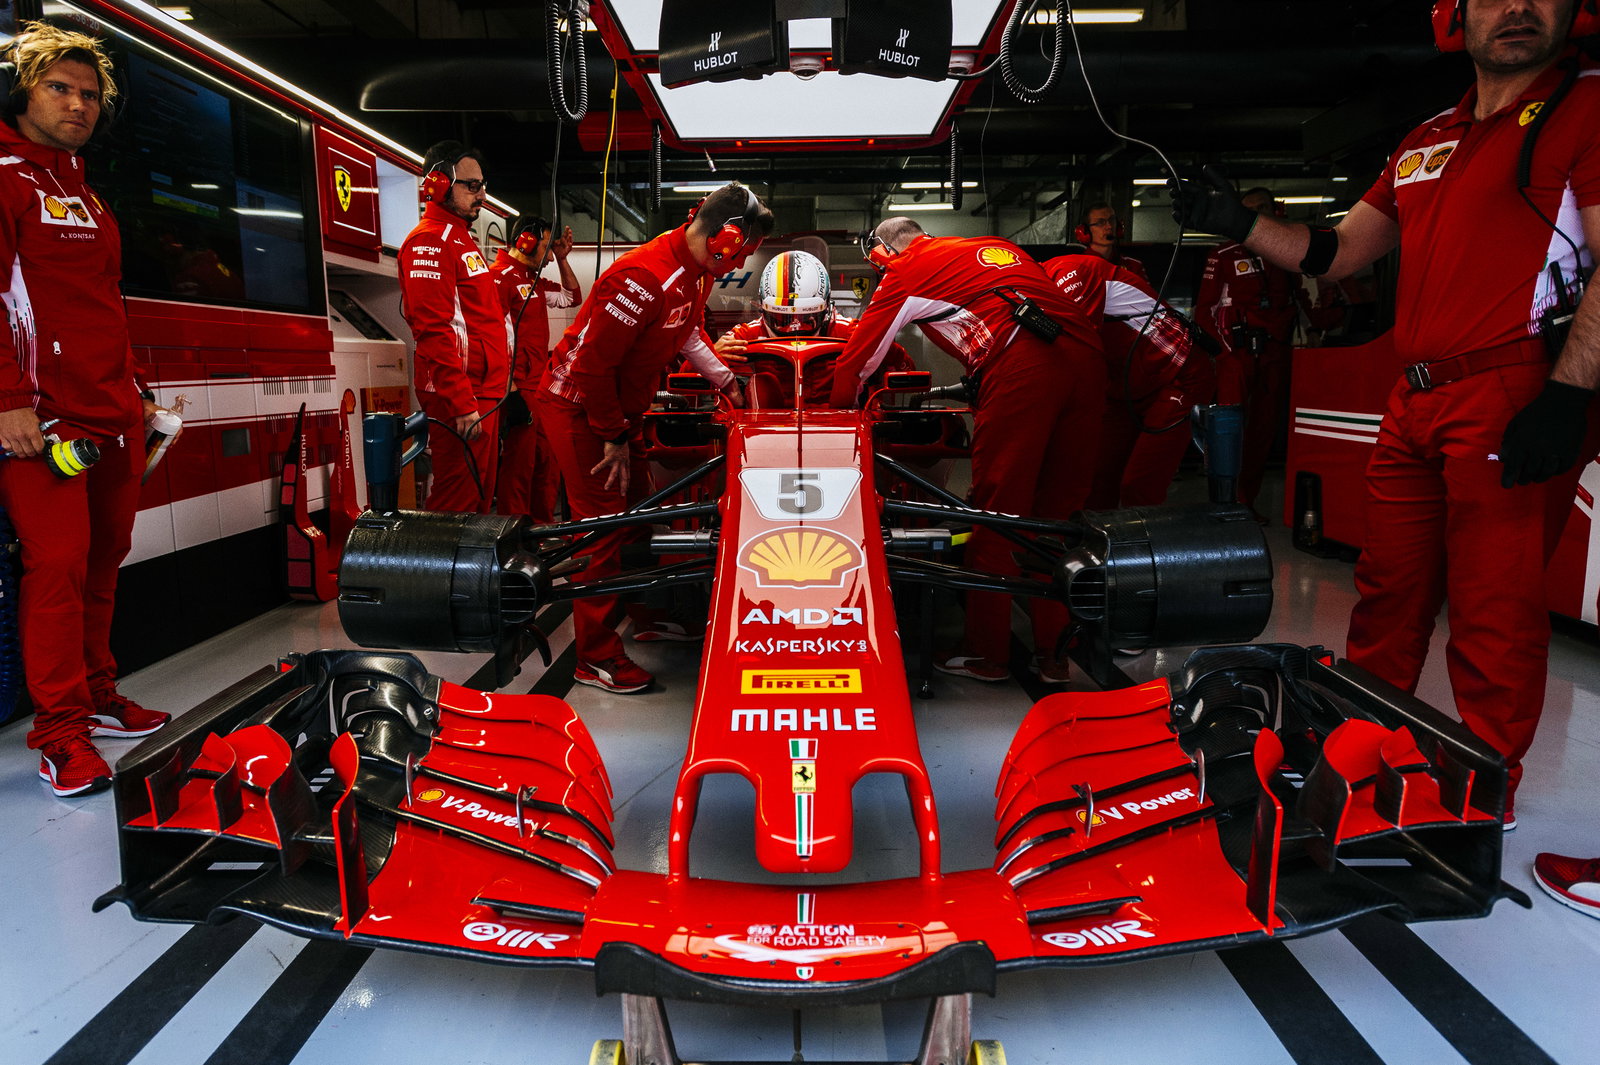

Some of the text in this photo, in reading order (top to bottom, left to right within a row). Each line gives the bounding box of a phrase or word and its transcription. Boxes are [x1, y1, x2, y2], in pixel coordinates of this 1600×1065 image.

[694, 51, 738, 72] HUBLOT
[878, 48, 921, 67] HUBLOT
[412, 259, 439, 268] MAHLE
[410, 270, 441, 280] PIRELLI
[624, 277, 655, 302] WEICHAI
[615, 293, 643, 315] MAHLE
[604, 302, 638, 327] PIRELLI
[777, 472, 824, 515] 5
[741, 608, 830, 625] AMD
[735, 637, 855, 655] KASPERSKY
[751, 674, 851, 689] PIRELLI
[731, 708, 877, 731] MAHLE
[1099, 788, 1195, 820] V Power
[778, 925, 855, 936] ACTION
[747, 936, 887, 947] FOR ROAD SAFETY
